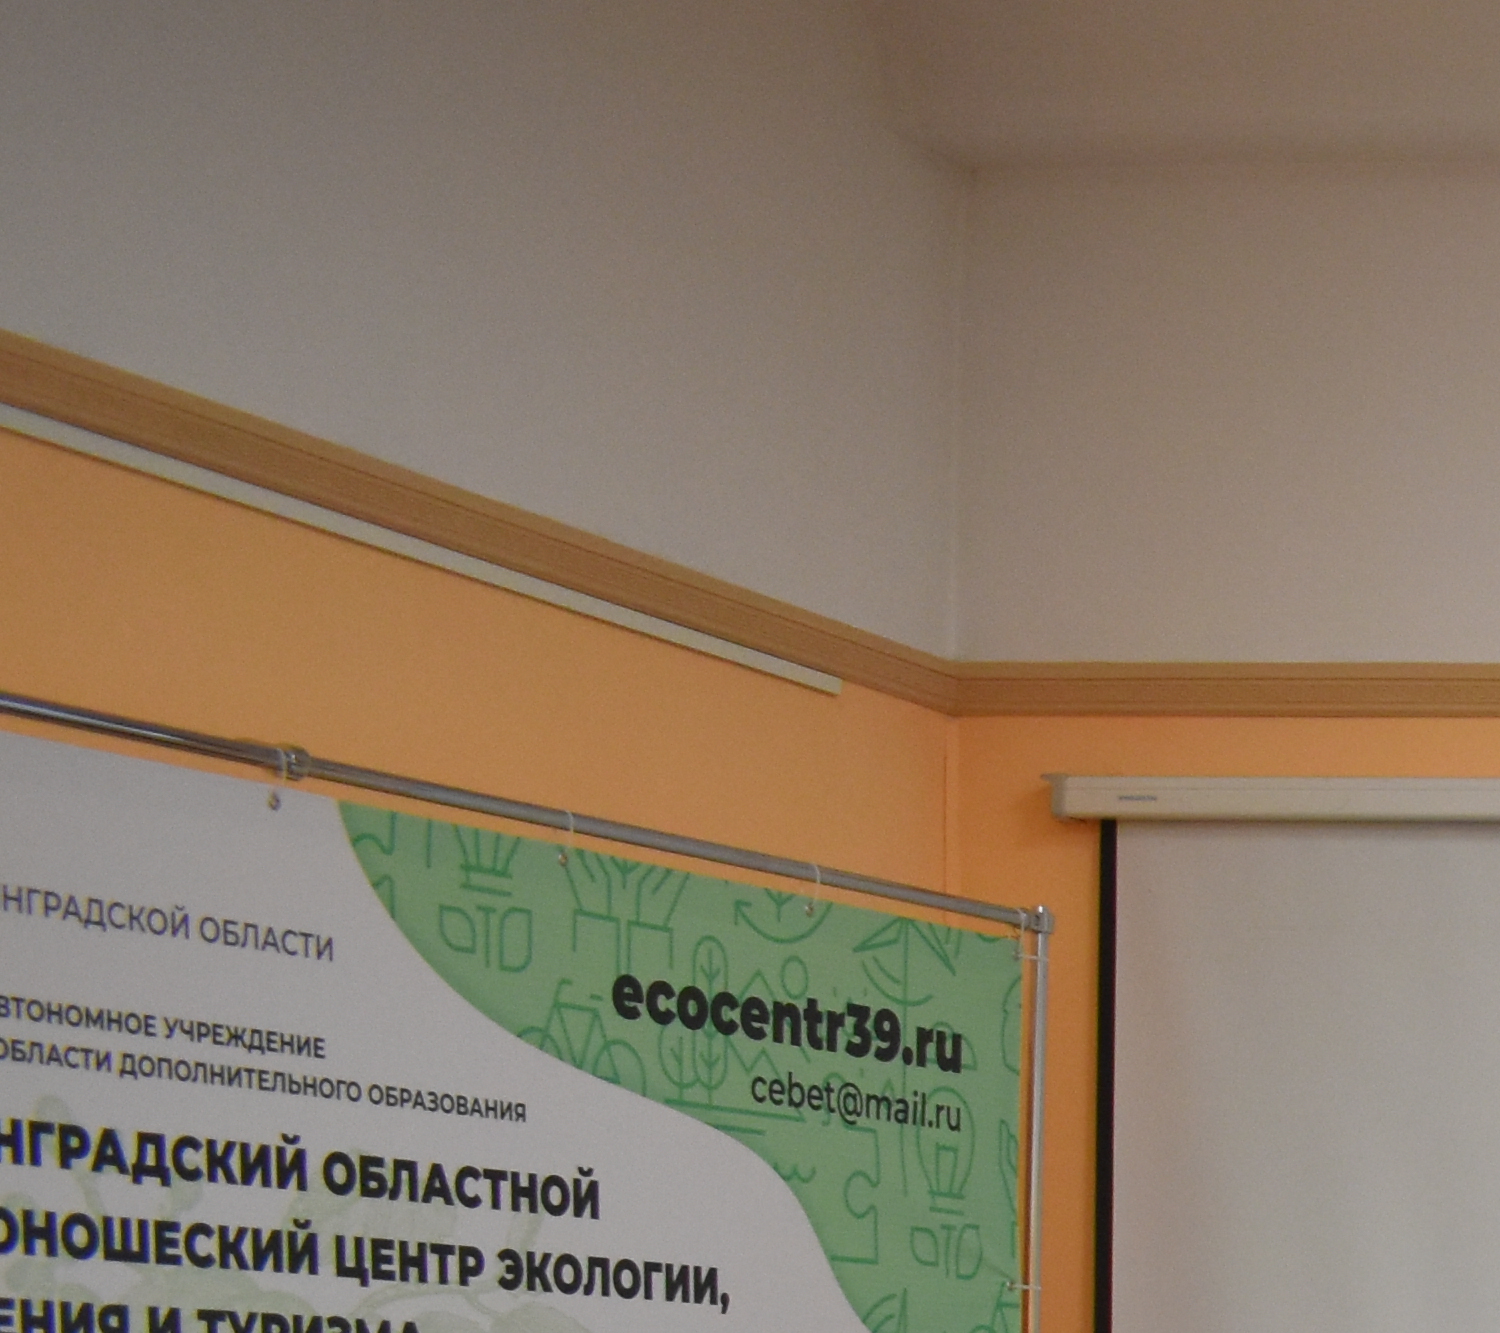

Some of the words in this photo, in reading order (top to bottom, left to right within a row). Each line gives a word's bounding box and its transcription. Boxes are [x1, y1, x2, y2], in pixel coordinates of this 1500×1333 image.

[199, 915, 334, 961] ОБЛАСТИ
[164, 1016, 325, 1059] УЧРЕЖДЕНИЕ
[611, 971, 962, 1075] ecocentr39.ru
[119, 1053, 362, 1102] ДОПОЛНИТЕЛЬНОГО
[368, 1085, 527, 1124] ОБРАЗОВАНИЯ
[749, 1069, 962, 1134] cebet@mail.ru
[322, 1150, 600, 1221] ОБЛАСТНОЙ
[334, 1232, 485, 1288] ЦЕНТР
[496, 1249, 731, 1315] ЭКОЛОГИИ,
